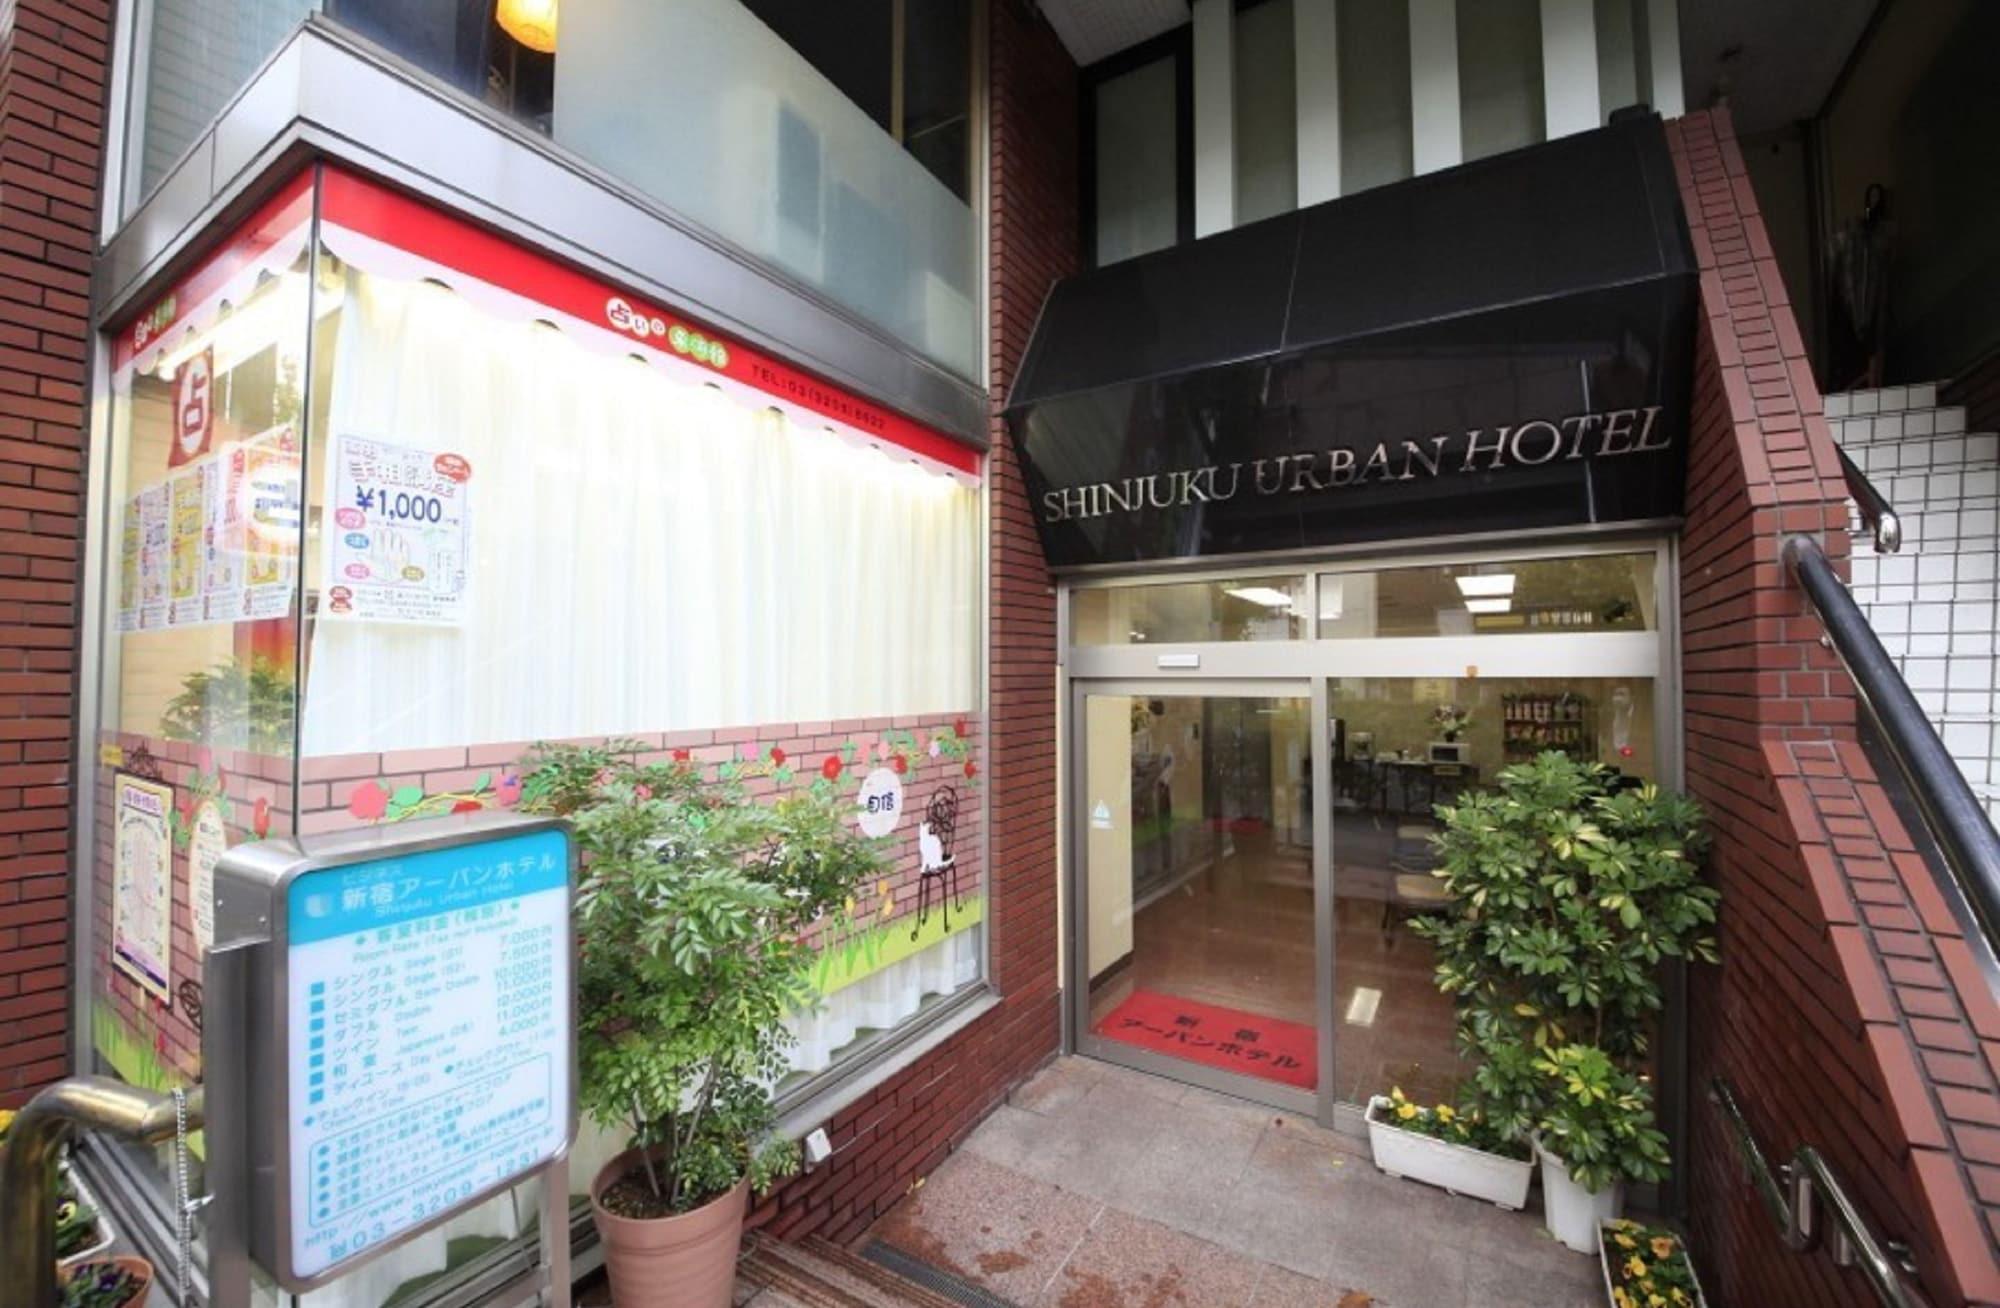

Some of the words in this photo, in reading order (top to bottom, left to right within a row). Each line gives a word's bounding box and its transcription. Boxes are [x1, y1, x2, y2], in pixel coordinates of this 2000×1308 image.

[1045, 461, 1242, 523] SHINJUKU
[1254, 436, 1448, 494] URBAN
[1458, 405, 1672, 472] HOTEL
[356, 484, 442, 523] ¥1,000
[342, 853, 555, 910] 新宿アーバンホテル
